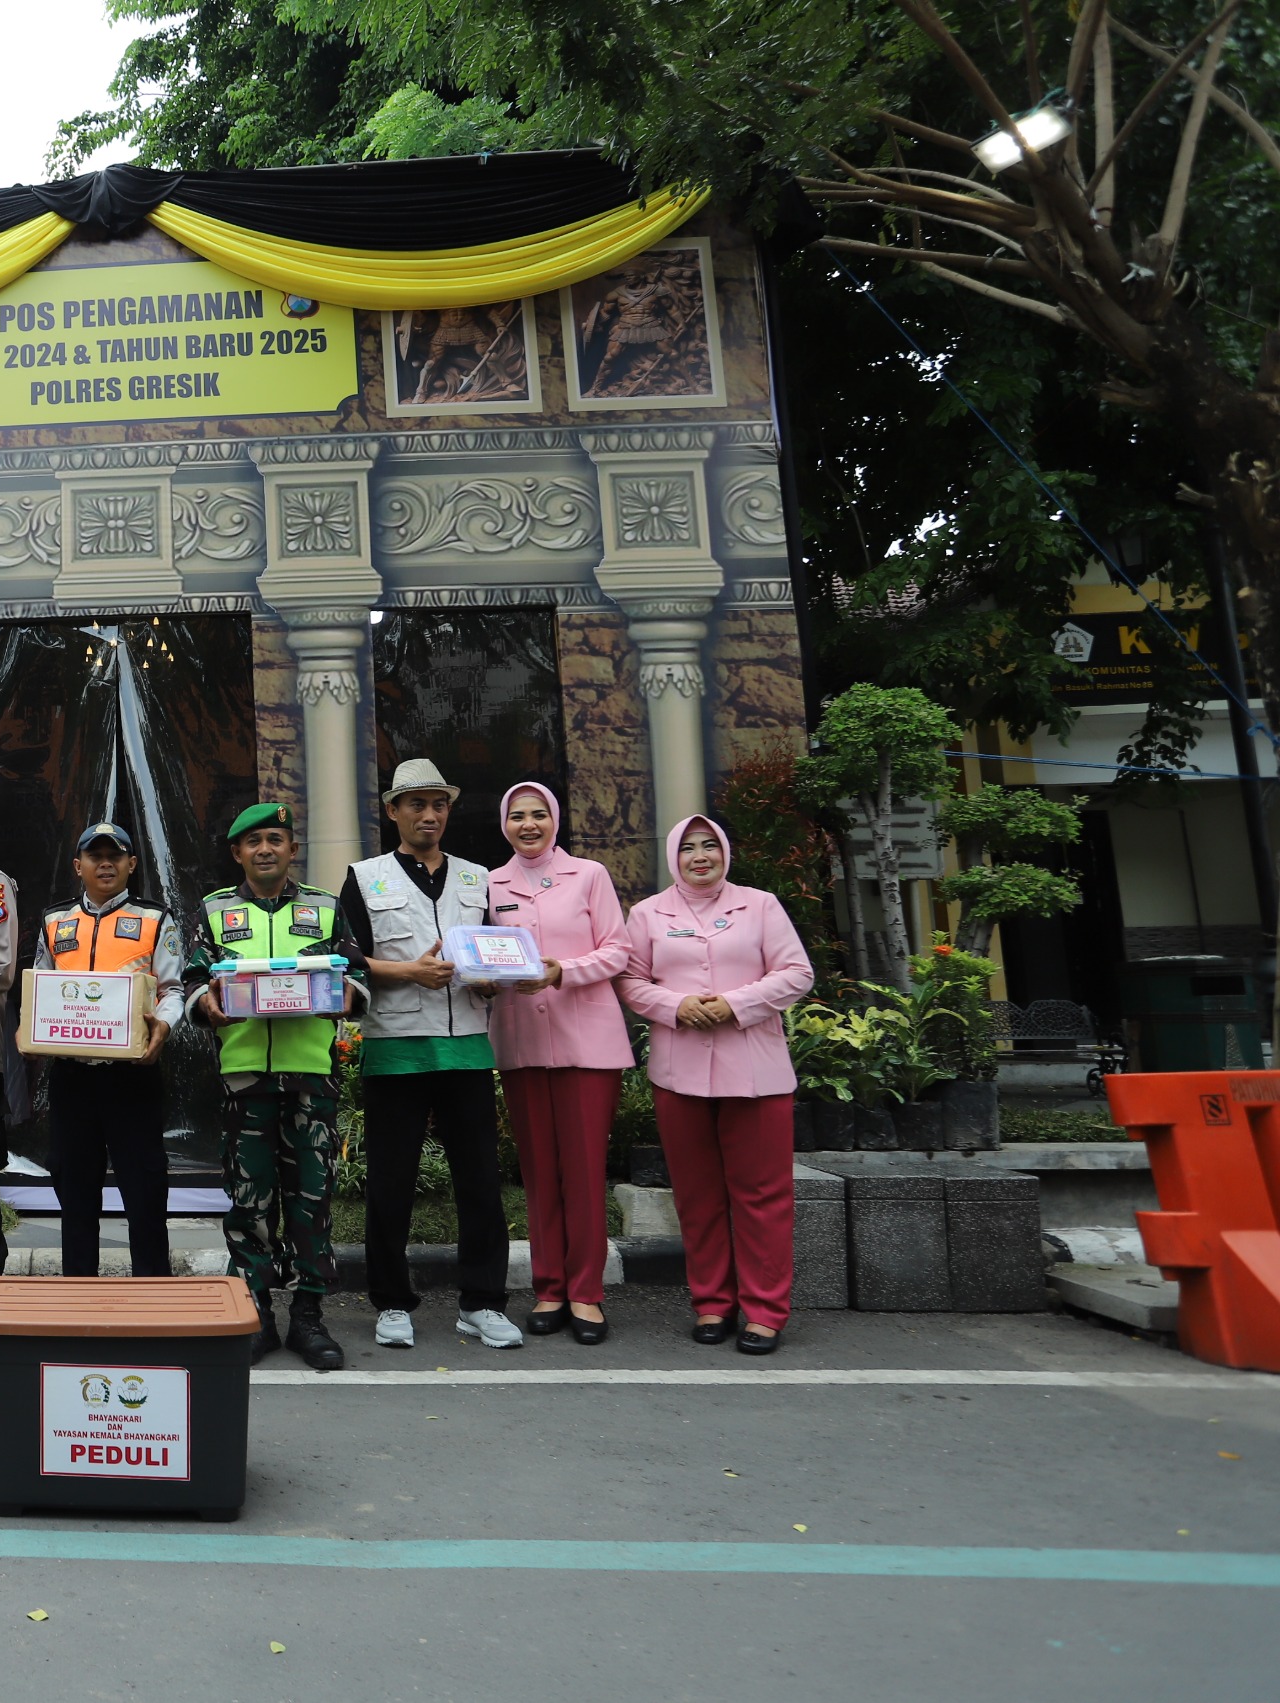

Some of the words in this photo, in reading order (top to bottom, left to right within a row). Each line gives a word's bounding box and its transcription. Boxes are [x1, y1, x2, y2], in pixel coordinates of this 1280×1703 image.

[0, 302, 55, 332] POS
[63, 290, 263, 329] PENGAMANAN
[4, 342, 67, 369] 2024
[73, 344, 91, 365] &
[96, 336, 178, 363] TAHUN
[185, 332, 253, 359] BARU
[260, 328, 327, 355] 2025
[30, 377, 122, 406] POLRES
[128, 372, 220, 400] GRESIK
[225, 931, 248, 940] HUDA
[63, 1004, 100, 1012] BHAYANGKARI
[266, 1000, 302, 1009] PEDULI
[85, 1019, 123, 1027] BHAYANGKARI
[49, 1025, 112, 1040] PEDULI
[88, 1414, 142, 1423] BHAYANGKARI
[107, 1423, 123, 1431] DAN
[53, 1429, 88, 1439] YAYASAN
[90, 1431, 121, 1440] KEMALA
[124, 1433, 180, 1442] BHAYANGKARI
[70, 1444, 168, 1466] PEDULI
